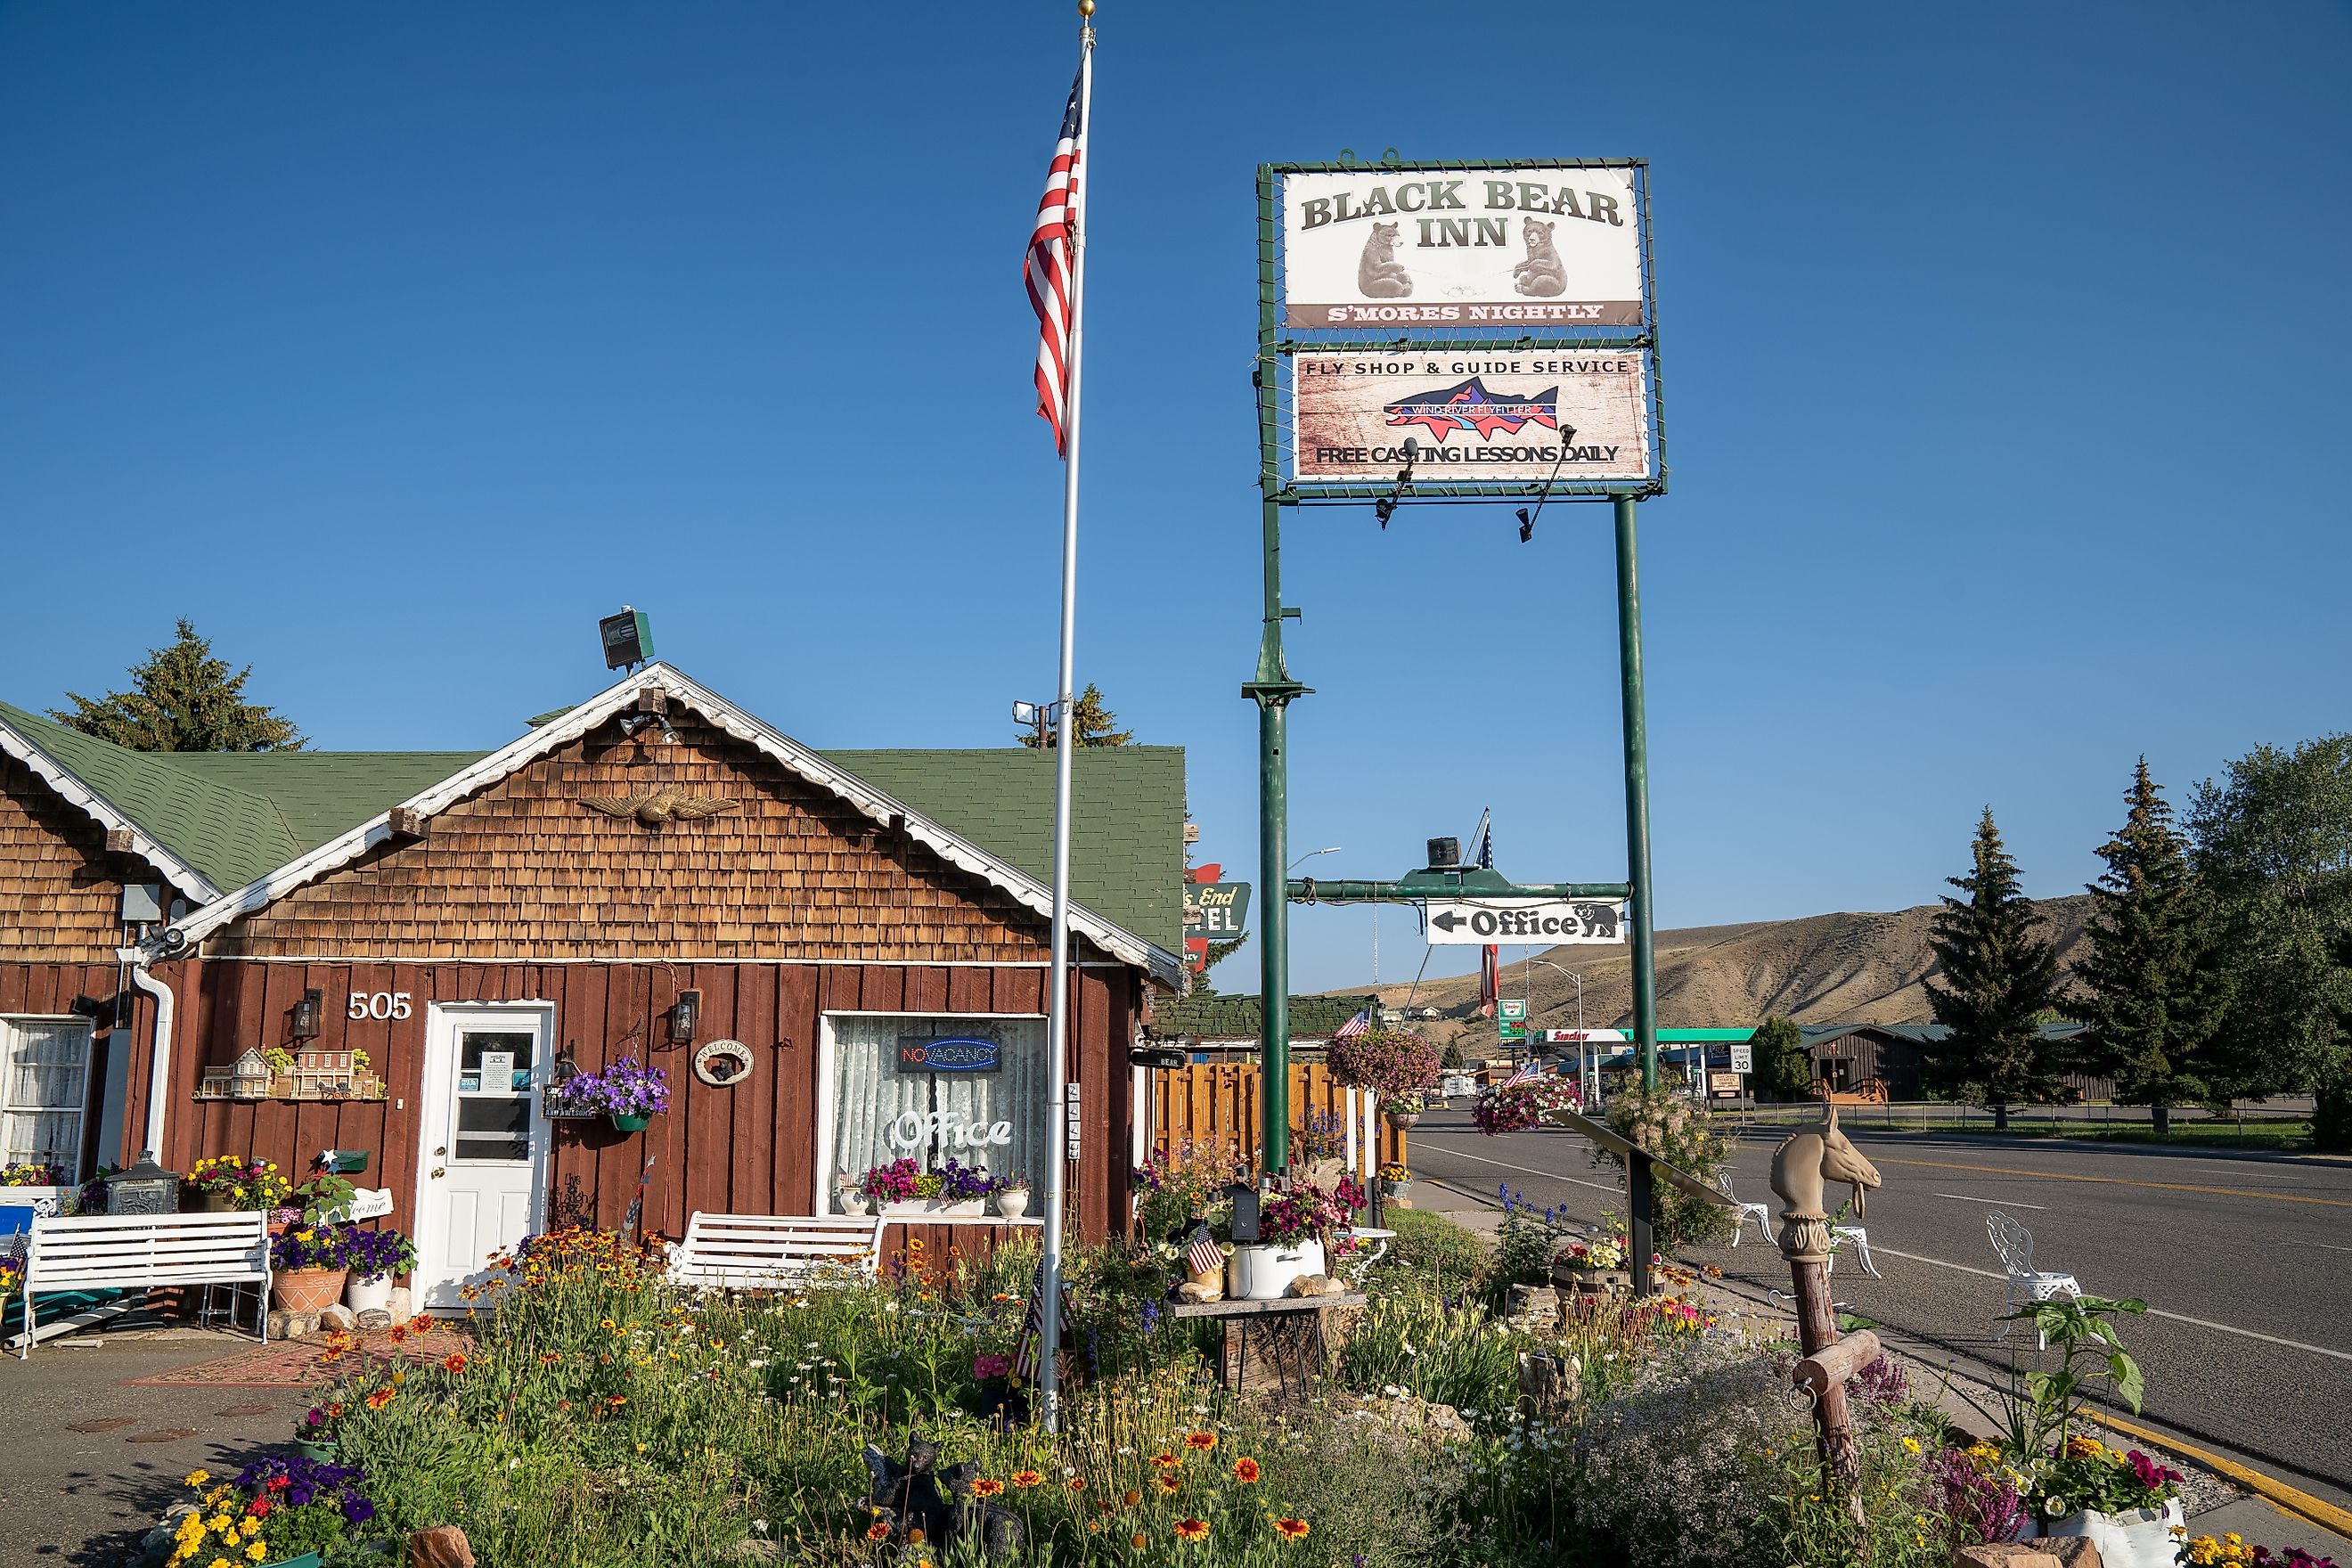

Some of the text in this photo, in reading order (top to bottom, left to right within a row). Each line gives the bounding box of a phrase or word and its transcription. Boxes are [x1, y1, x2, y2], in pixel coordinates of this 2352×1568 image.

[1301, 180, 1624, 231] BLACK BEAR
[1416, 216, 1509, 248] INN
[1327, 304, 1604, 322] S'MORES NIGHTLY
[1305, 360, 1629, 375] FLY SHOP & GUIDE SERVICE
[1411, 404, 1532, 415] WIND RIVER FLYFITTER
[1316, 445, 1620, 463] FREE CASTING LESSONS DAILY
[1198, 886, 1238, 906] End
[1470, 910, 1579, 936] Office
[347, 991, 412, 1021] 505
[699, 1041, 747, 1058] WELCOME
[902, 1047, 998, 1062] NO VACANCY
[1734, 1060, 1749, 1070] 30
[559, 1108, 592, 1117] AWESOM
[894, 1110, 1011, 1150] Office
